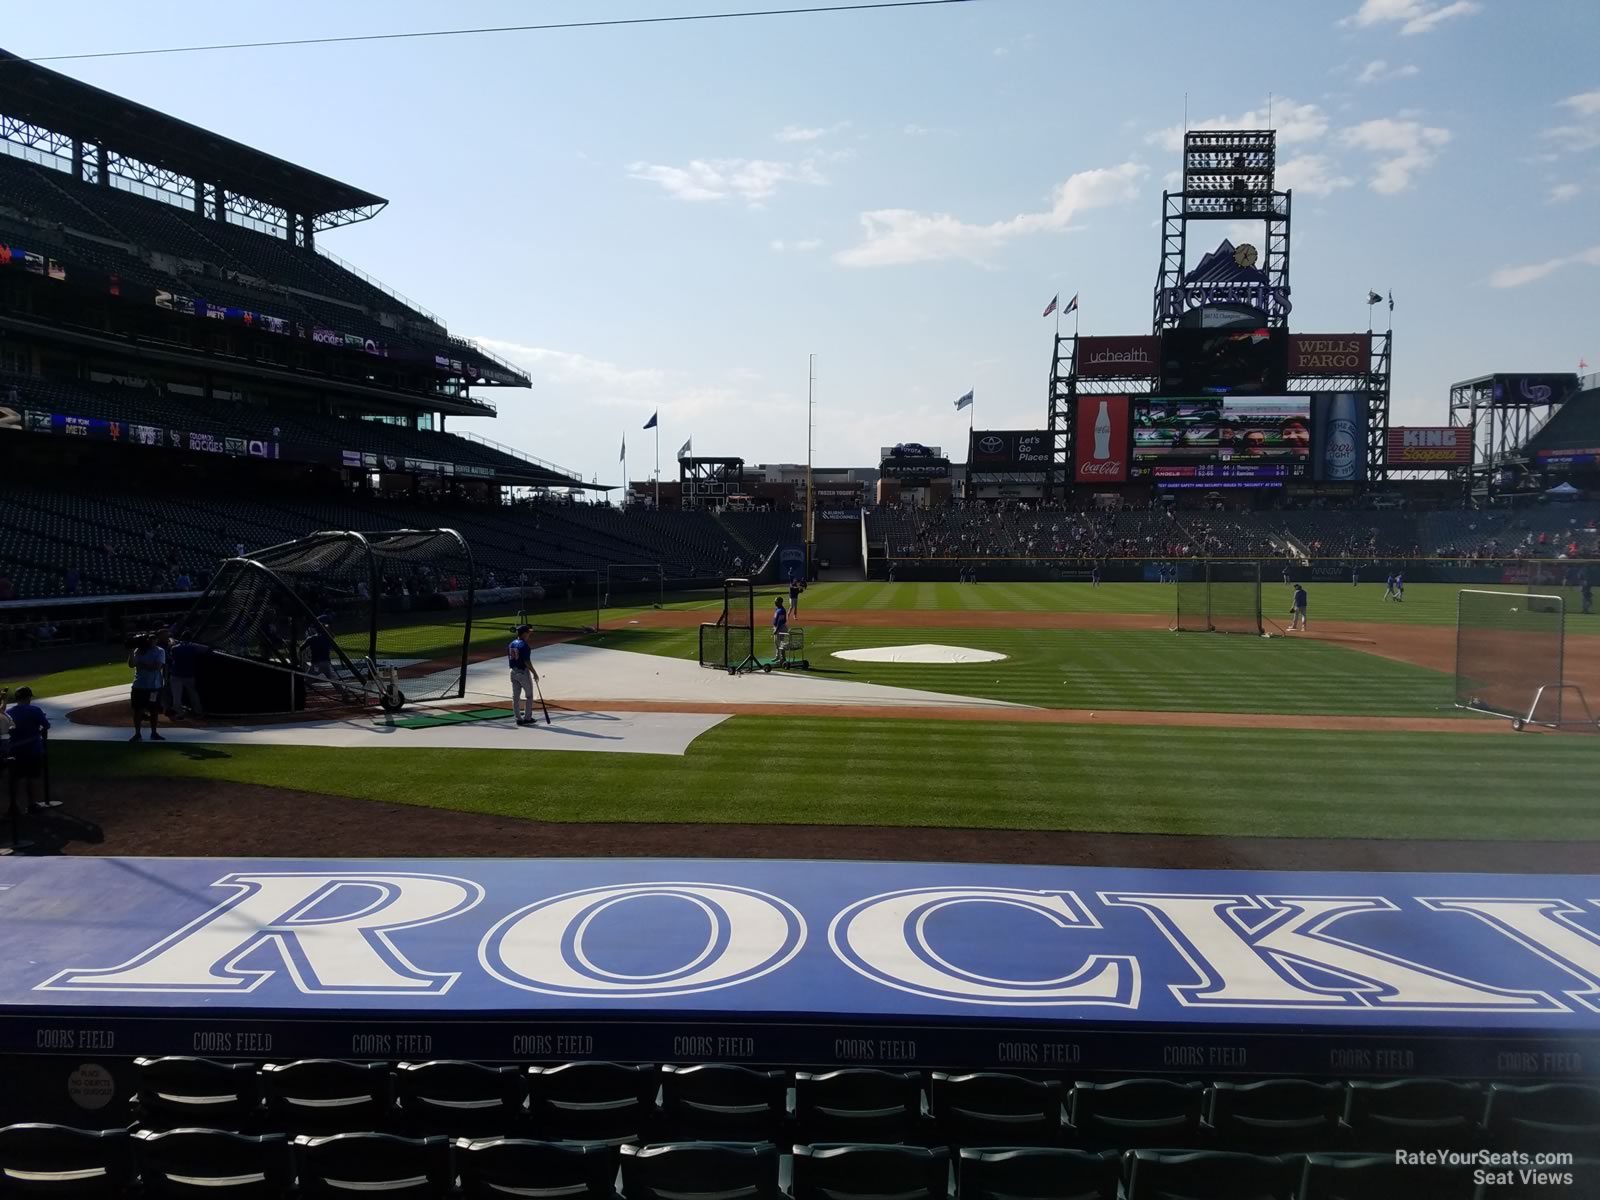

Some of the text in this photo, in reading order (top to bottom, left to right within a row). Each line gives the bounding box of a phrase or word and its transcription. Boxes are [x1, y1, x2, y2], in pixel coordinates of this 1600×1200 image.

[1161, 286, 1293, 318] ROCKIES
[206, 310, 225, 320] METS
[312, 332, 344, 347] ROCKIES
[1299, 341, 1360, 353] WELLS
[1090, 347, 1148, 361] uchealth
[1299, 355, 1359, 367] FARGO
[65, 424, 88, 436] METS
[189, 432, 214, 442] COLORADO
[1019, 436, 1040, 444] Let's
[1403, 430, 1457, 446] KING
[189, 439, 224, 453] ROCKIES
[900, 446, 922, 454] TOYOTA
[1403, 446, 1457, 461] Soopers
[1018, 453, 1049, 461] Places
[1081, 461, 1120, 475] Coca-Cola
[32, 871, 1600, 1012] ROCKI
[37, 1029, 115, 1049] COORS FIELD
[193, 1031, 273, 1052] COORS FIELD
[352, 1034, 432, 1054] COORS FIELD
[512, 1035, 593, 1055] COORS FIELD
[673, 1036, 754, 1057] COORS FIELD
[835, 1039, 916, 1060] COORS FIELD
[998, 1042, 1081, 1063] COORS FIELD
[1163, 1045, 1247, 1066] COORS FIELD
[1330, 1048, 1414, 1070] COORS FIELD
[1497, 1051, 1582, 1073] COORS FIELD
